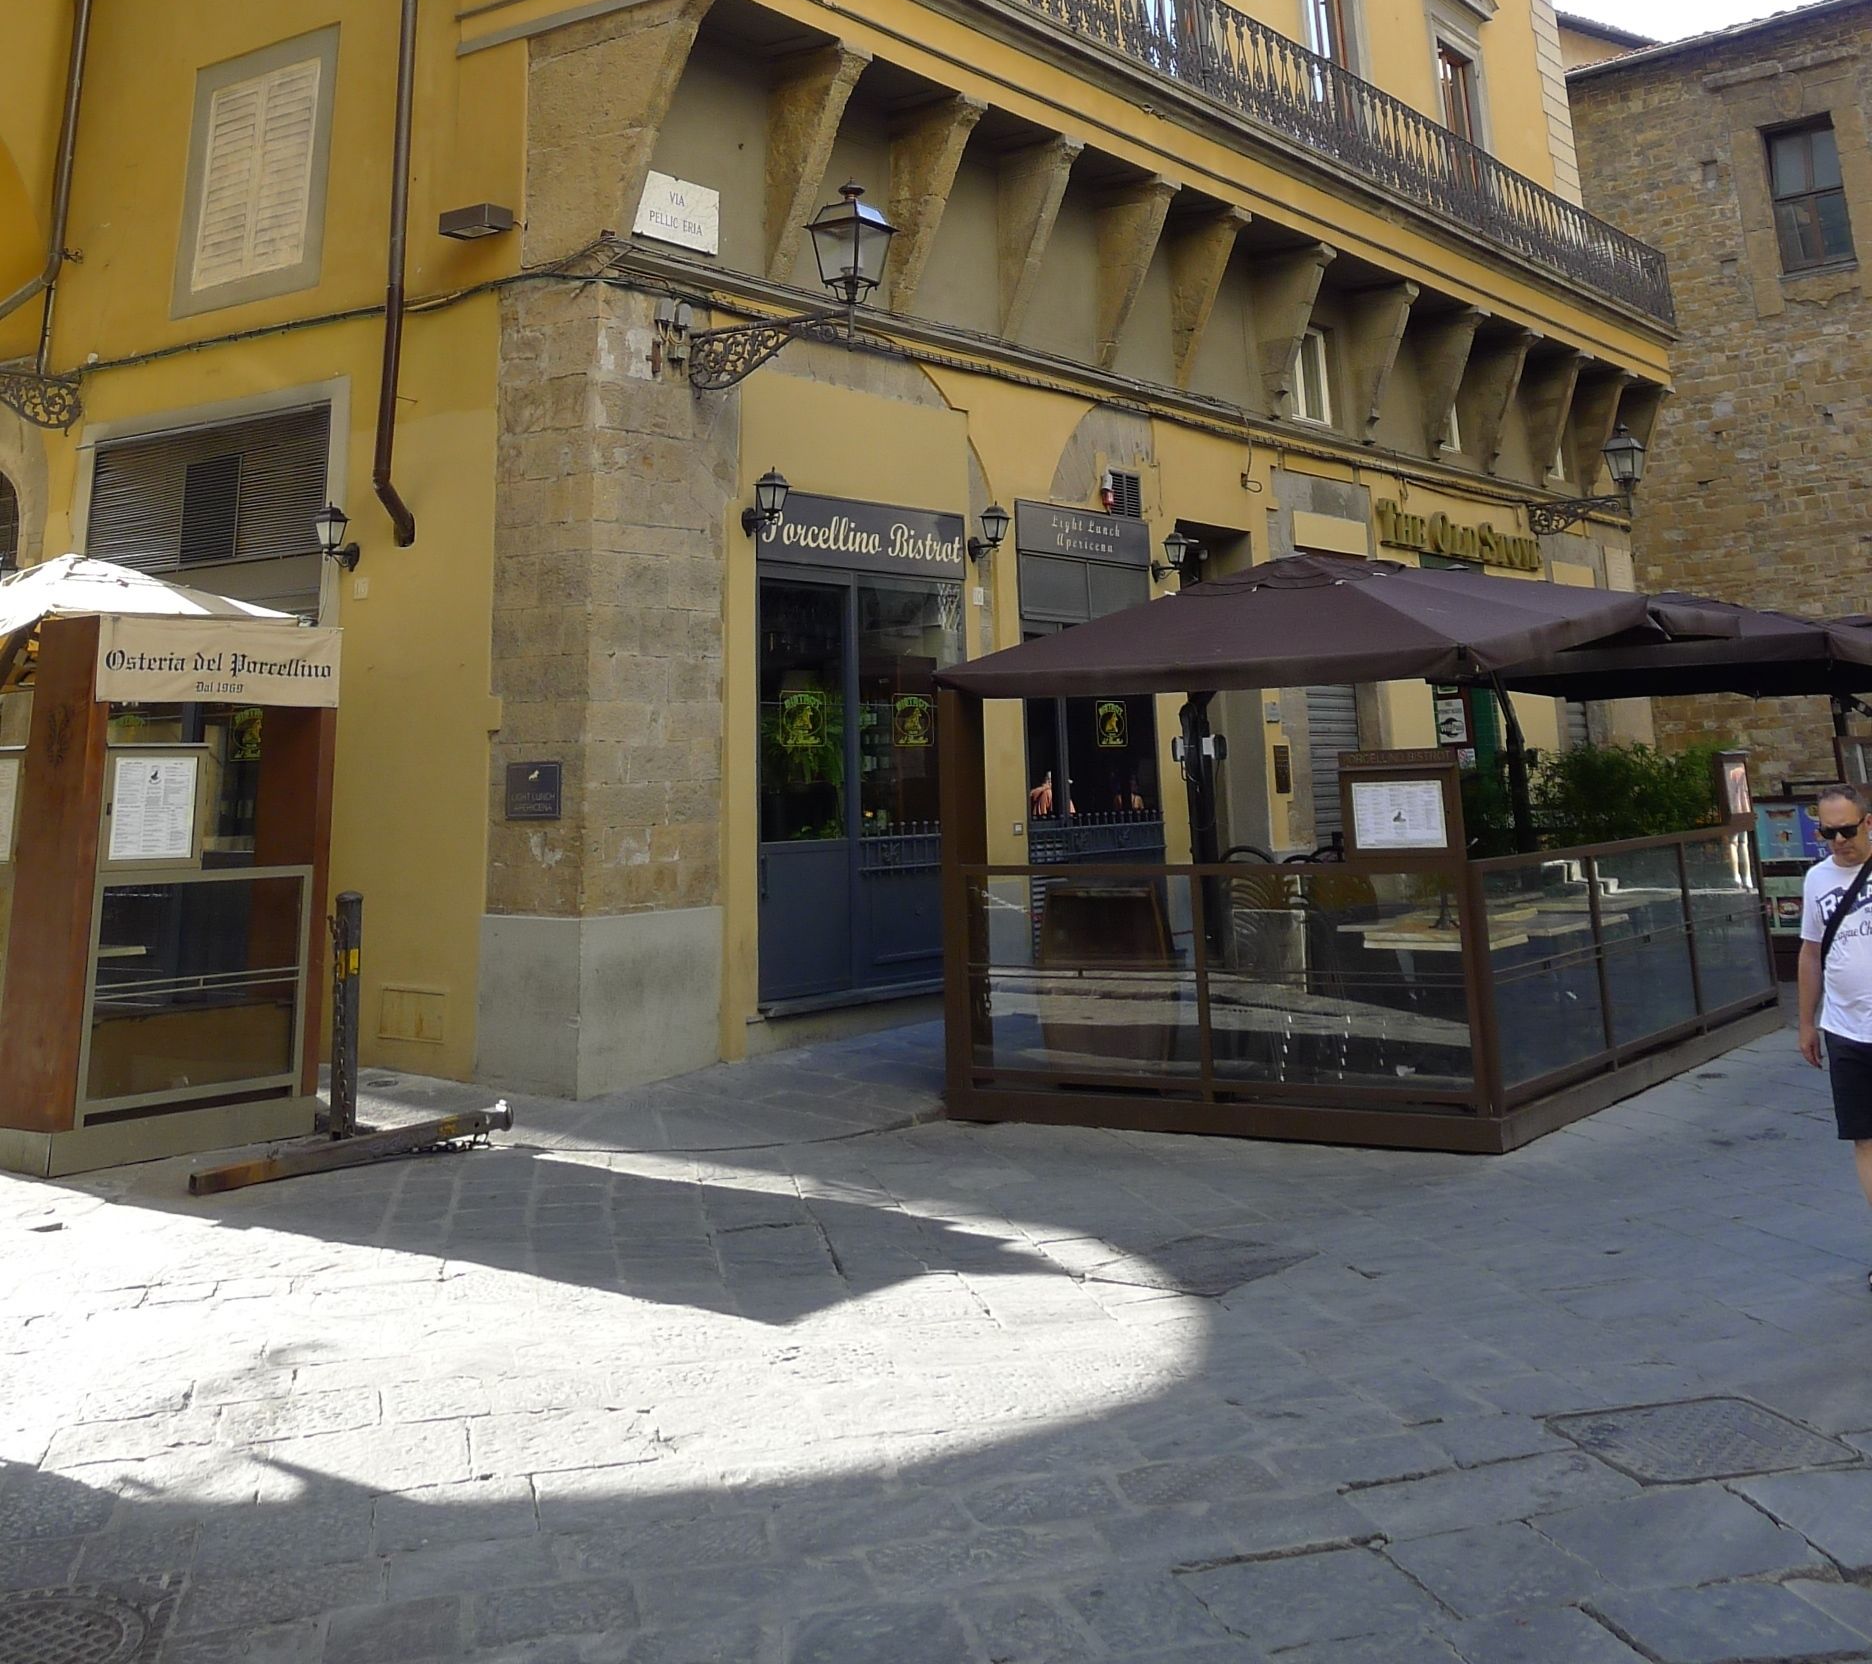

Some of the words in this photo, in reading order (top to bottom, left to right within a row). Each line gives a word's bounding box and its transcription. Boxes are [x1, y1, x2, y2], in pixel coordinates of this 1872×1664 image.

[669, 191, 685, 207] VIA
[1052, 515, 1082, 533] Light
[1087, 519, 1120, 537] Lunch
[1376, 497, 1426, 549] THE
[1478, 521, 1544, 570] STOVE
[762, 511, 881, 554] Porcellino
[888, 523, 962, 564] Bistrot
[1056, 533, 1113, 552] Apericena
[105, 649, 186, 672] Osteria
[192, 652, 223, 672] del
[230, 653, 332, 678] Porcellino
[195, 681, 214, 693] Dal
[216, 682, 244, 694] 1969
